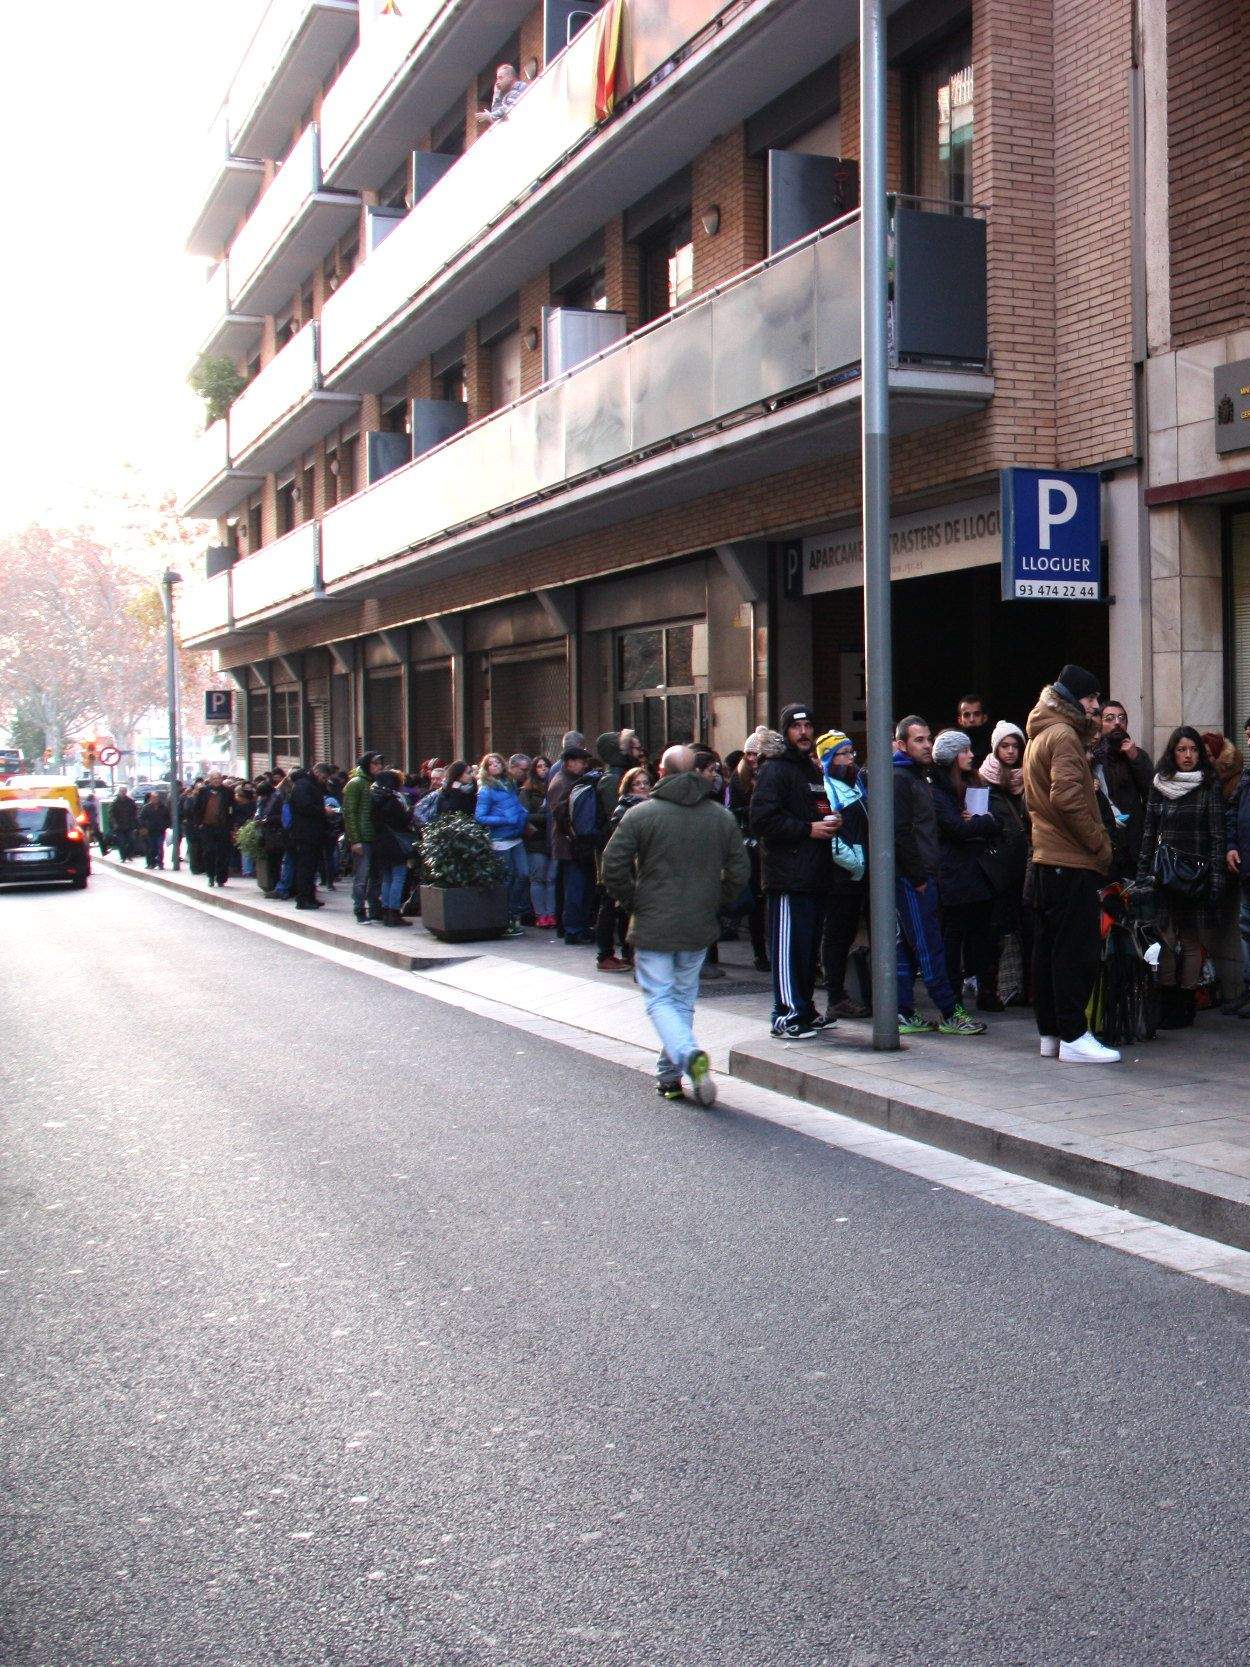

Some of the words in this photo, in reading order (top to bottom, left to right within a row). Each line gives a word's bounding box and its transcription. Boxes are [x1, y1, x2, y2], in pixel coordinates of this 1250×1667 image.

[1038, 478, 1078, 550] P
[944, 521, 960, 543] DE
[1022, 556, 1091, 573] LLOGUER
[1019, 584, 1034, 597] 93
[1037, 584, 1059, 597] 474
[1062, 584, 1076, 597] 22
[1080, 584, 1095, 597] 44
[212, 693, 226, 713] P
